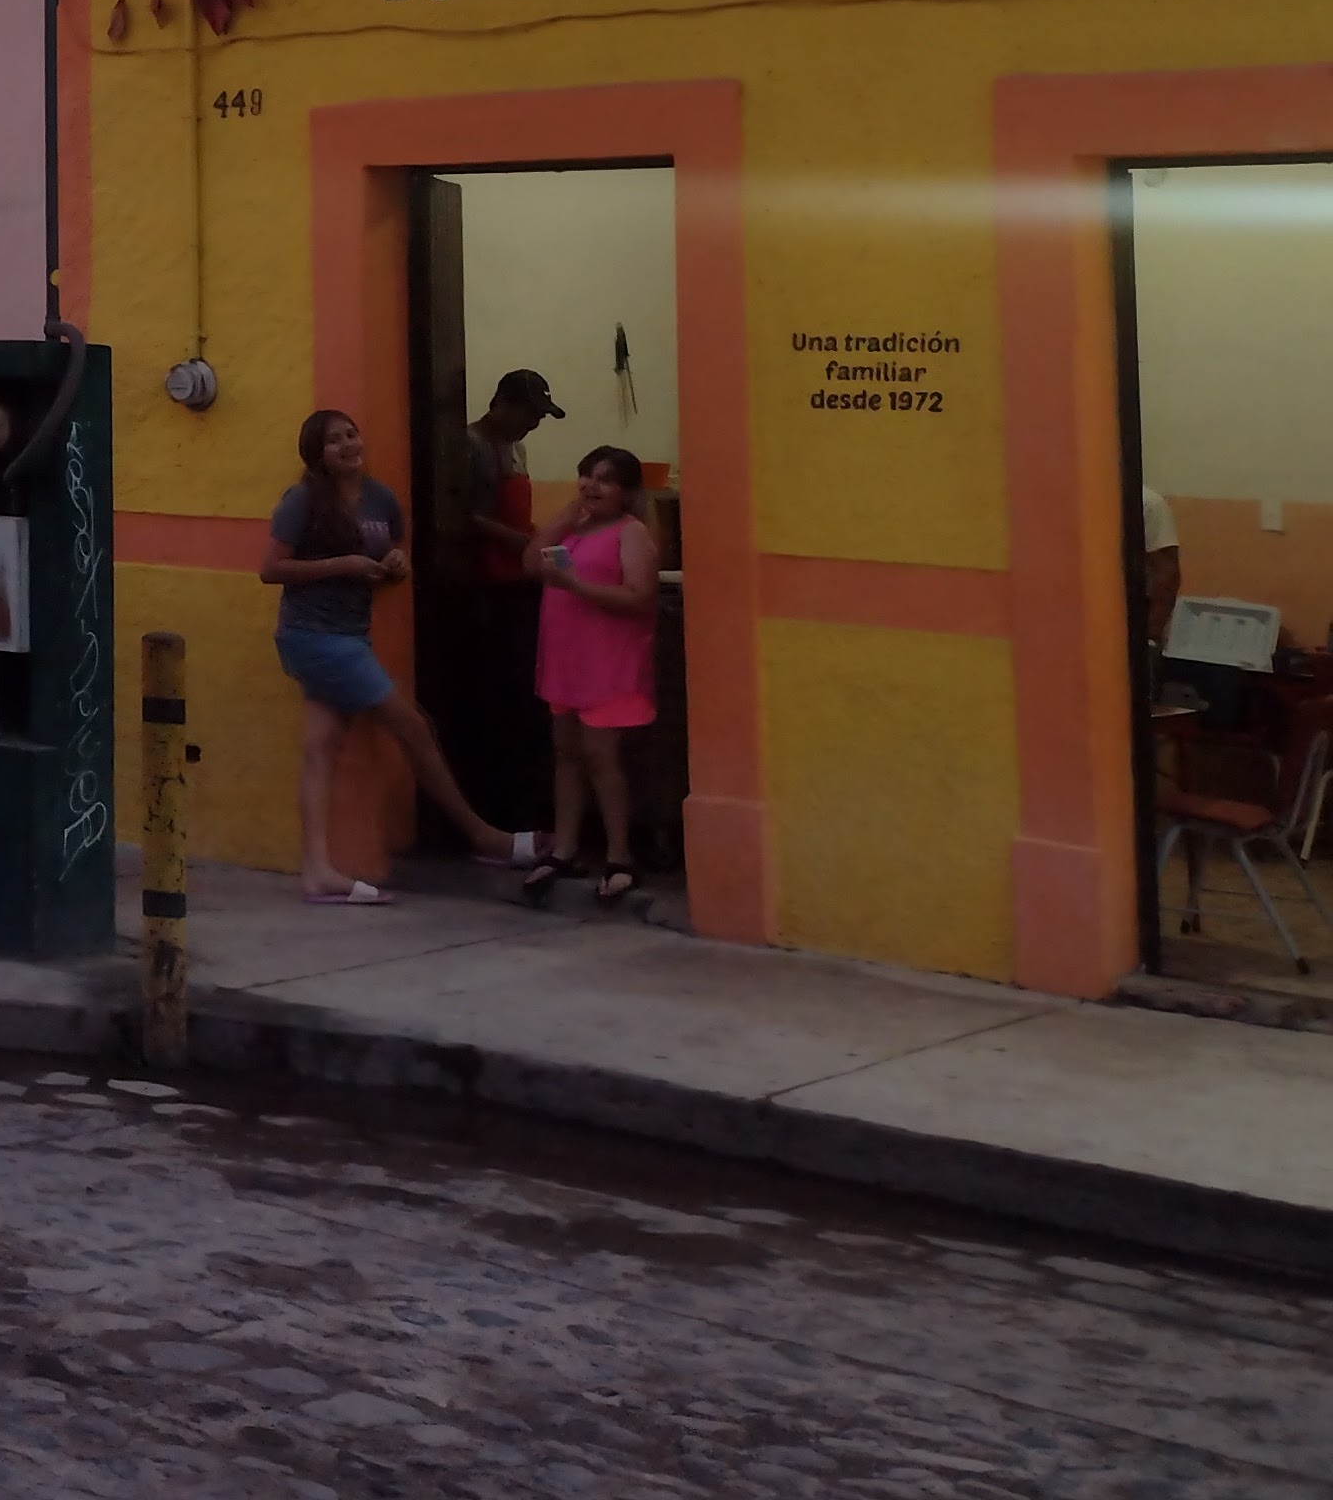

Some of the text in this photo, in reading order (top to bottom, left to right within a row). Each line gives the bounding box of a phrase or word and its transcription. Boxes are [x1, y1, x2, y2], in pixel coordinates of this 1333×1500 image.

[212, 87, 263, 119] 449
[791, 330, 960, 353] Una tradición
[824, 360, 927, 382] familiar
[809, 389, 943, 412] desde 1972
